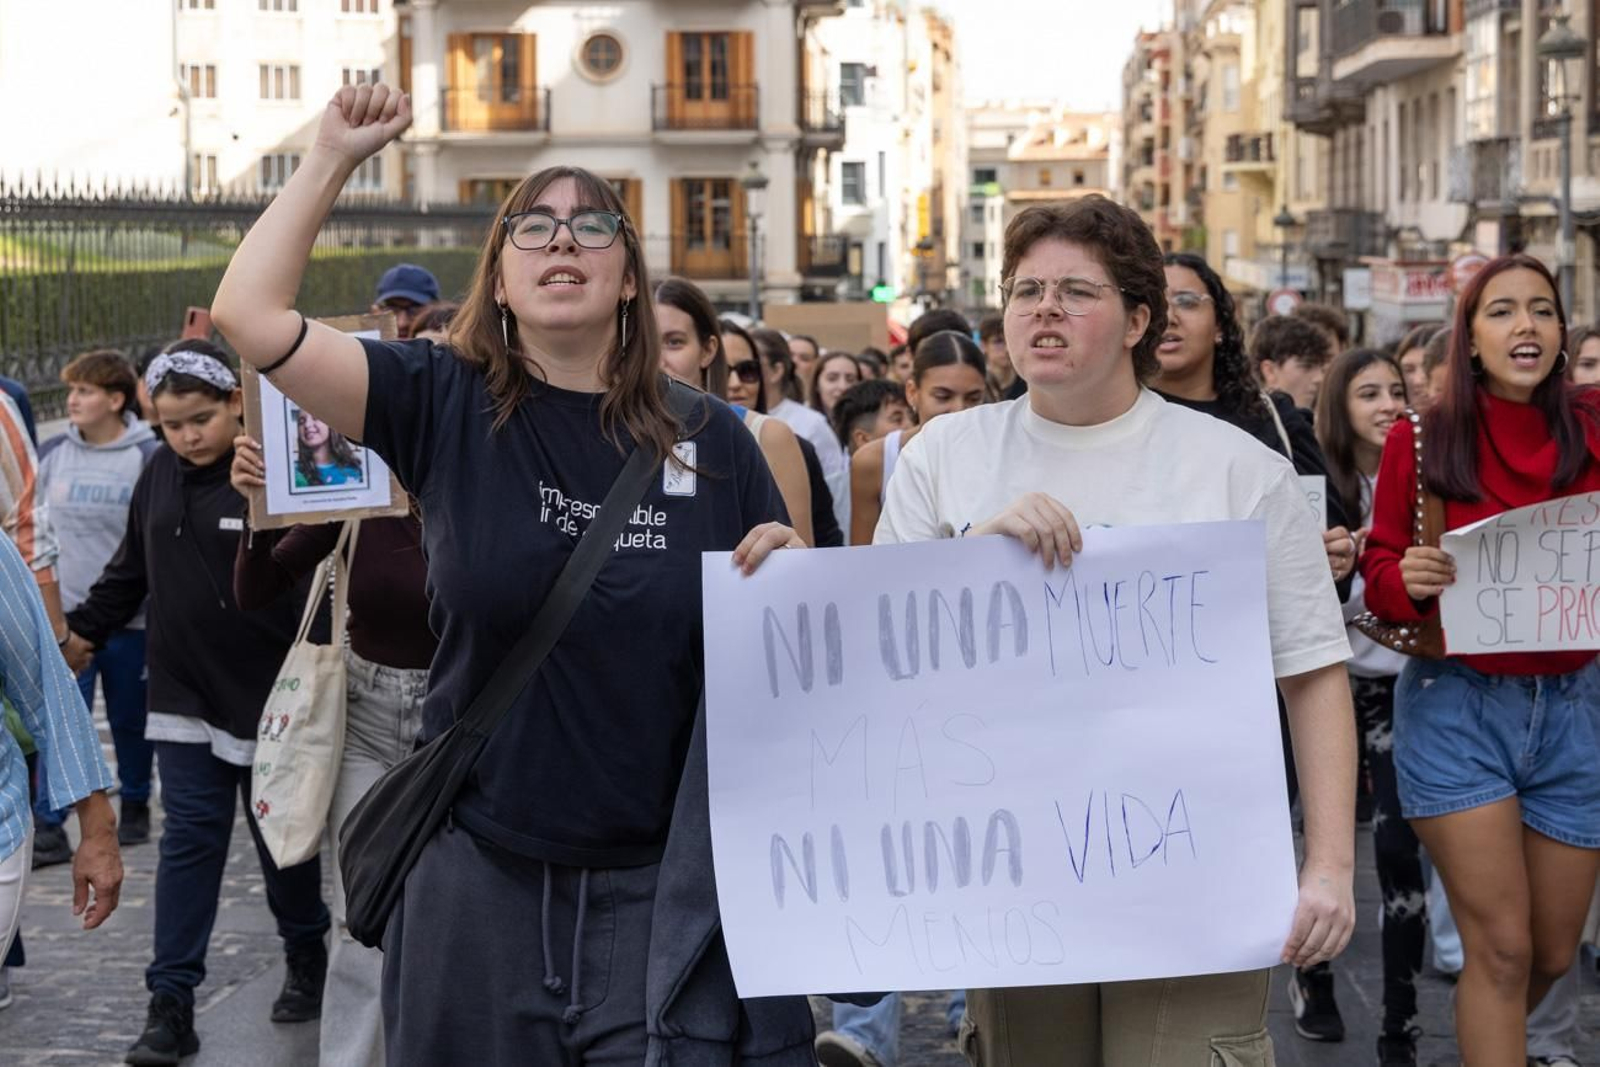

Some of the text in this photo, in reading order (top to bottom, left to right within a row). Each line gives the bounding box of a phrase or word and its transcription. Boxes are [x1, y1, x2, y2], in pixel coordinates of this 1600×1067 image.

[1477, 529, 1520, 585] NO
[762, 569, 1219, 698] NI UNA MUERTE
[1476, 586, 1525, 647] SE
[810, 699, 996, 816] MÁS
[769, 788, 1197, 910] NI UNA VIDA
[845, 899, 1066, 976] MENOS
